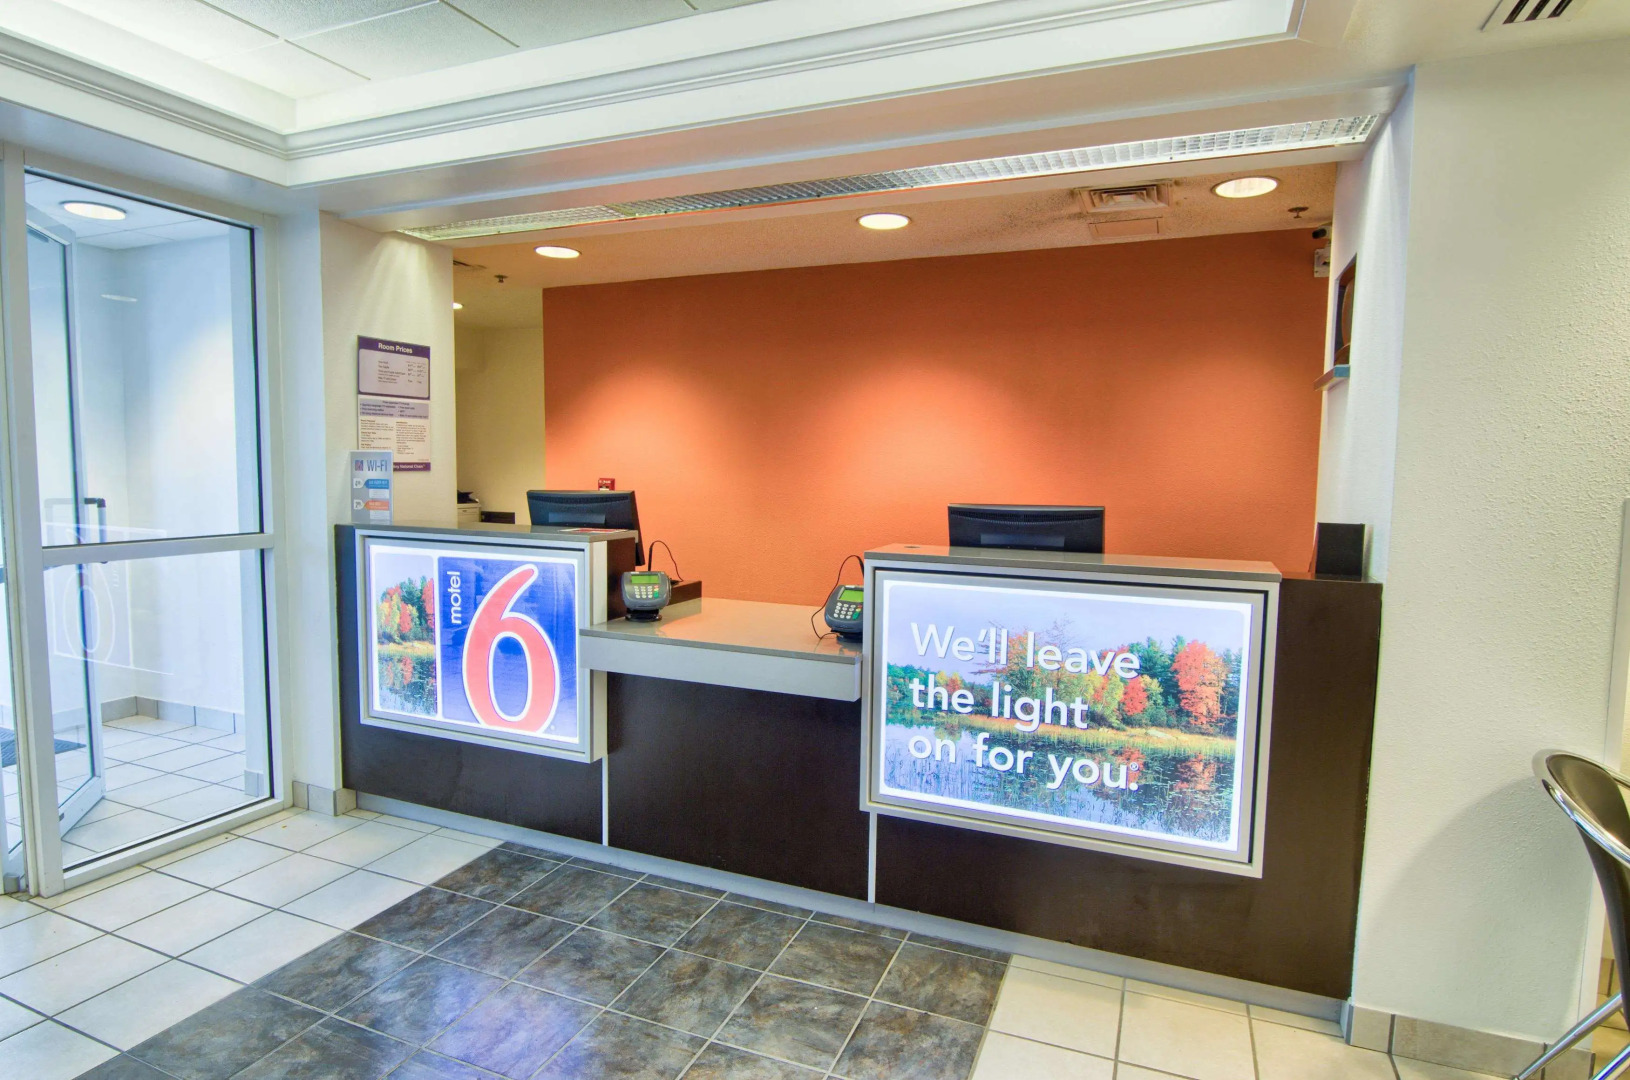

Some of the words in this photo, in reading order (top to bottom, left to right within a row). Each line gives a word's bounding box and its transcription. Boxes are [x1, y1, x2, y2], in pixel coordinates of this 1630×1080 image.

[378, 343, 395, 351] Room
[395, 345, 413, 354] Prices
[367, 459, 387, 471] WI-FI
[447, 571, 462, 624] motel
[462, 564, 561, 733] 6
[910, 622, 1008, 666] We'll
[1026, 631, 1141, 679] leave
[909, 674, 975, 714] the
[991, 681, 1089, 733] light
[908, 734, 957, 763] on
[972, 733, 1034, 774] for
